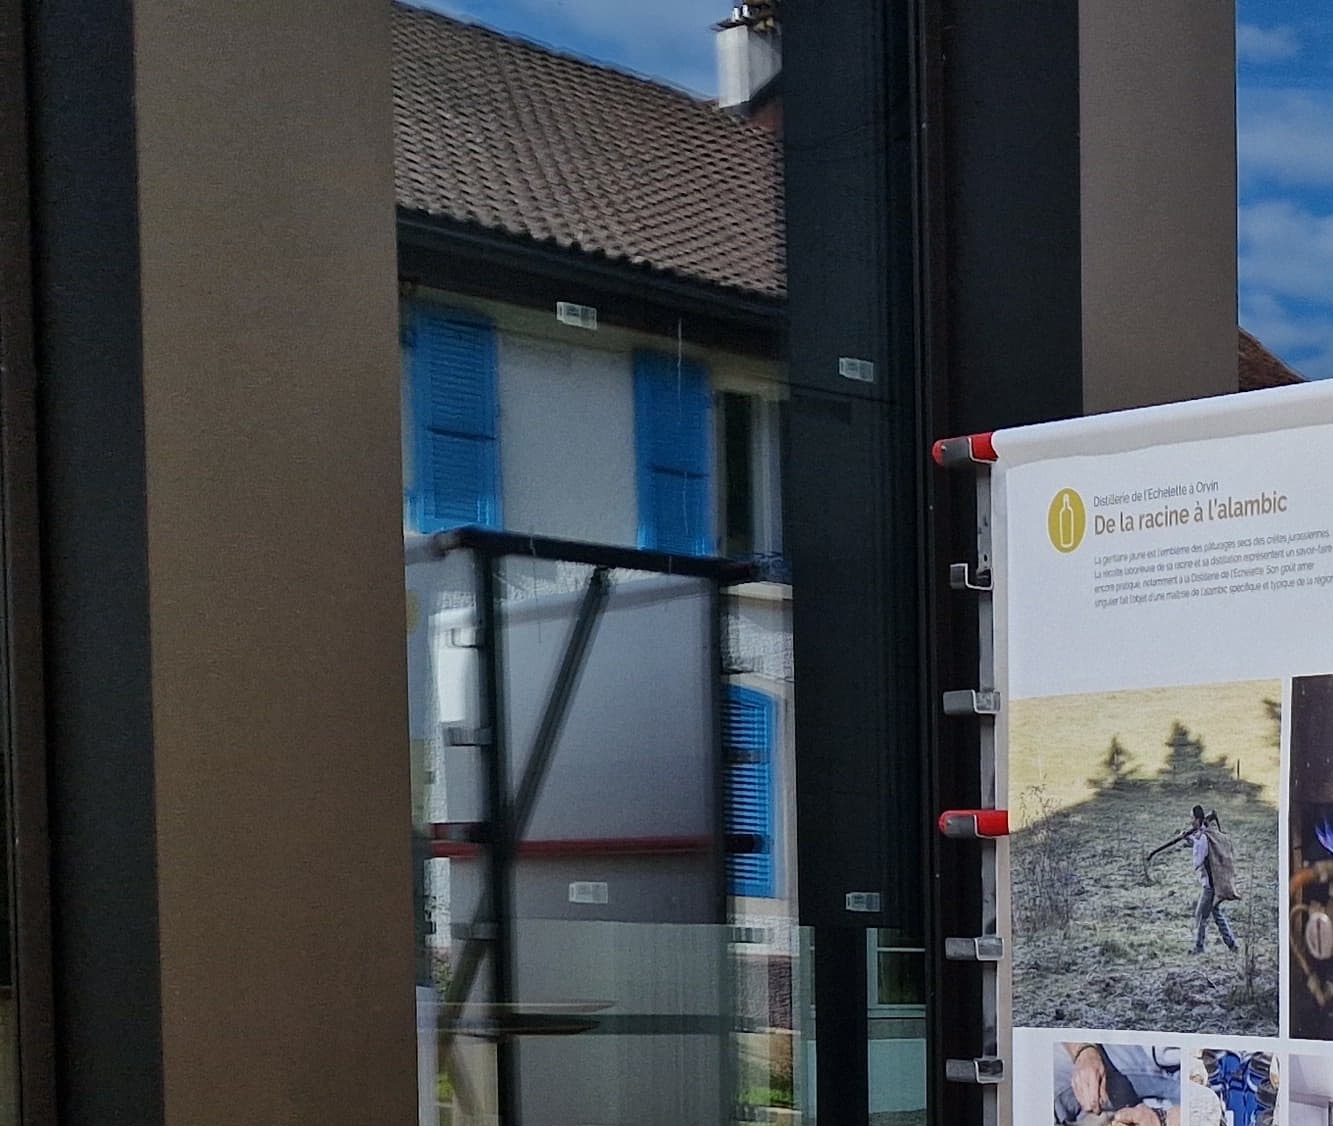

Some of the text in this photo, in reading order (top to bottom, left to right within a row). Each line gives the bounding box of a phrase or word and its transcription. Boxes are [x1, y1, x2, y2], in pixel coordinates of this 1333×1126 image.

[1093, 494, 1130, 507] Distillerie
[1131, 490, 1142, 502] de
[1196, 480, 1219, 494] Orvin
[1094, 491, 1288, 536] De la racine à l'alambic
